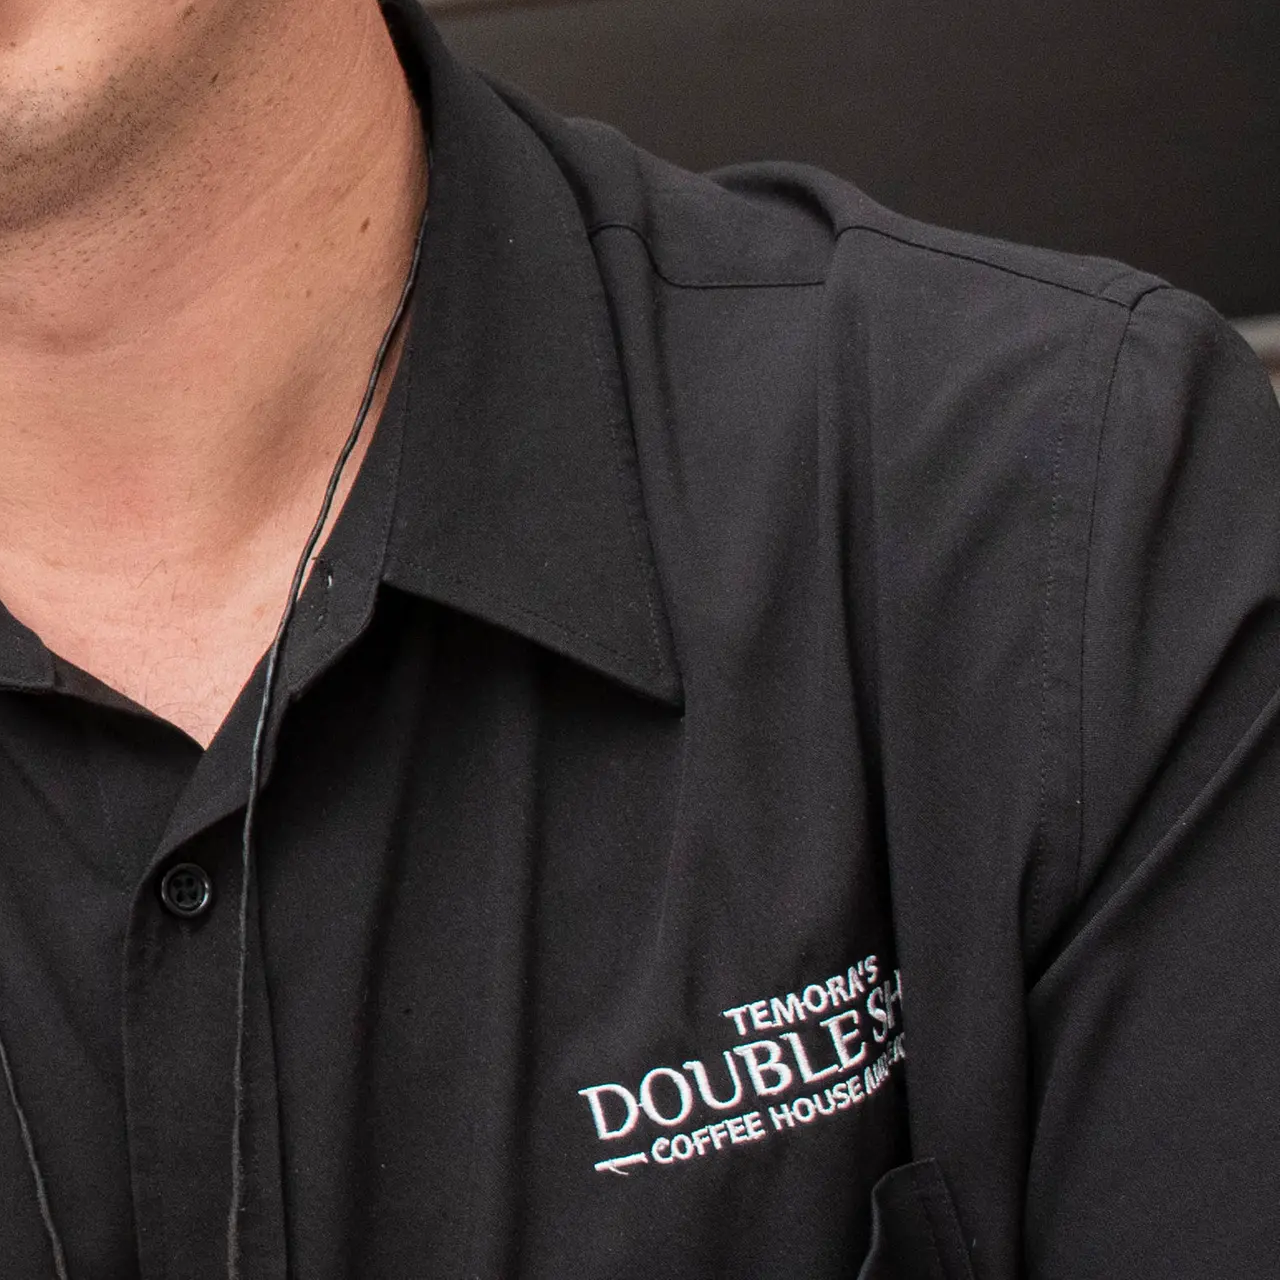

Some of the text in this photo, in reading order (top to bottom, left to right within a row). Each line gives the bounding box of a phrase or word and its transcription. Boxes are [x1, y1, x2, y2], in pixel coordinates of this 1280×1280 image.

[722, 955, 879, 1036] TEMORA'S
[651, 1111, 767, 1164] COFFEE
[768, 1075, 865, 1131] HOUSE
